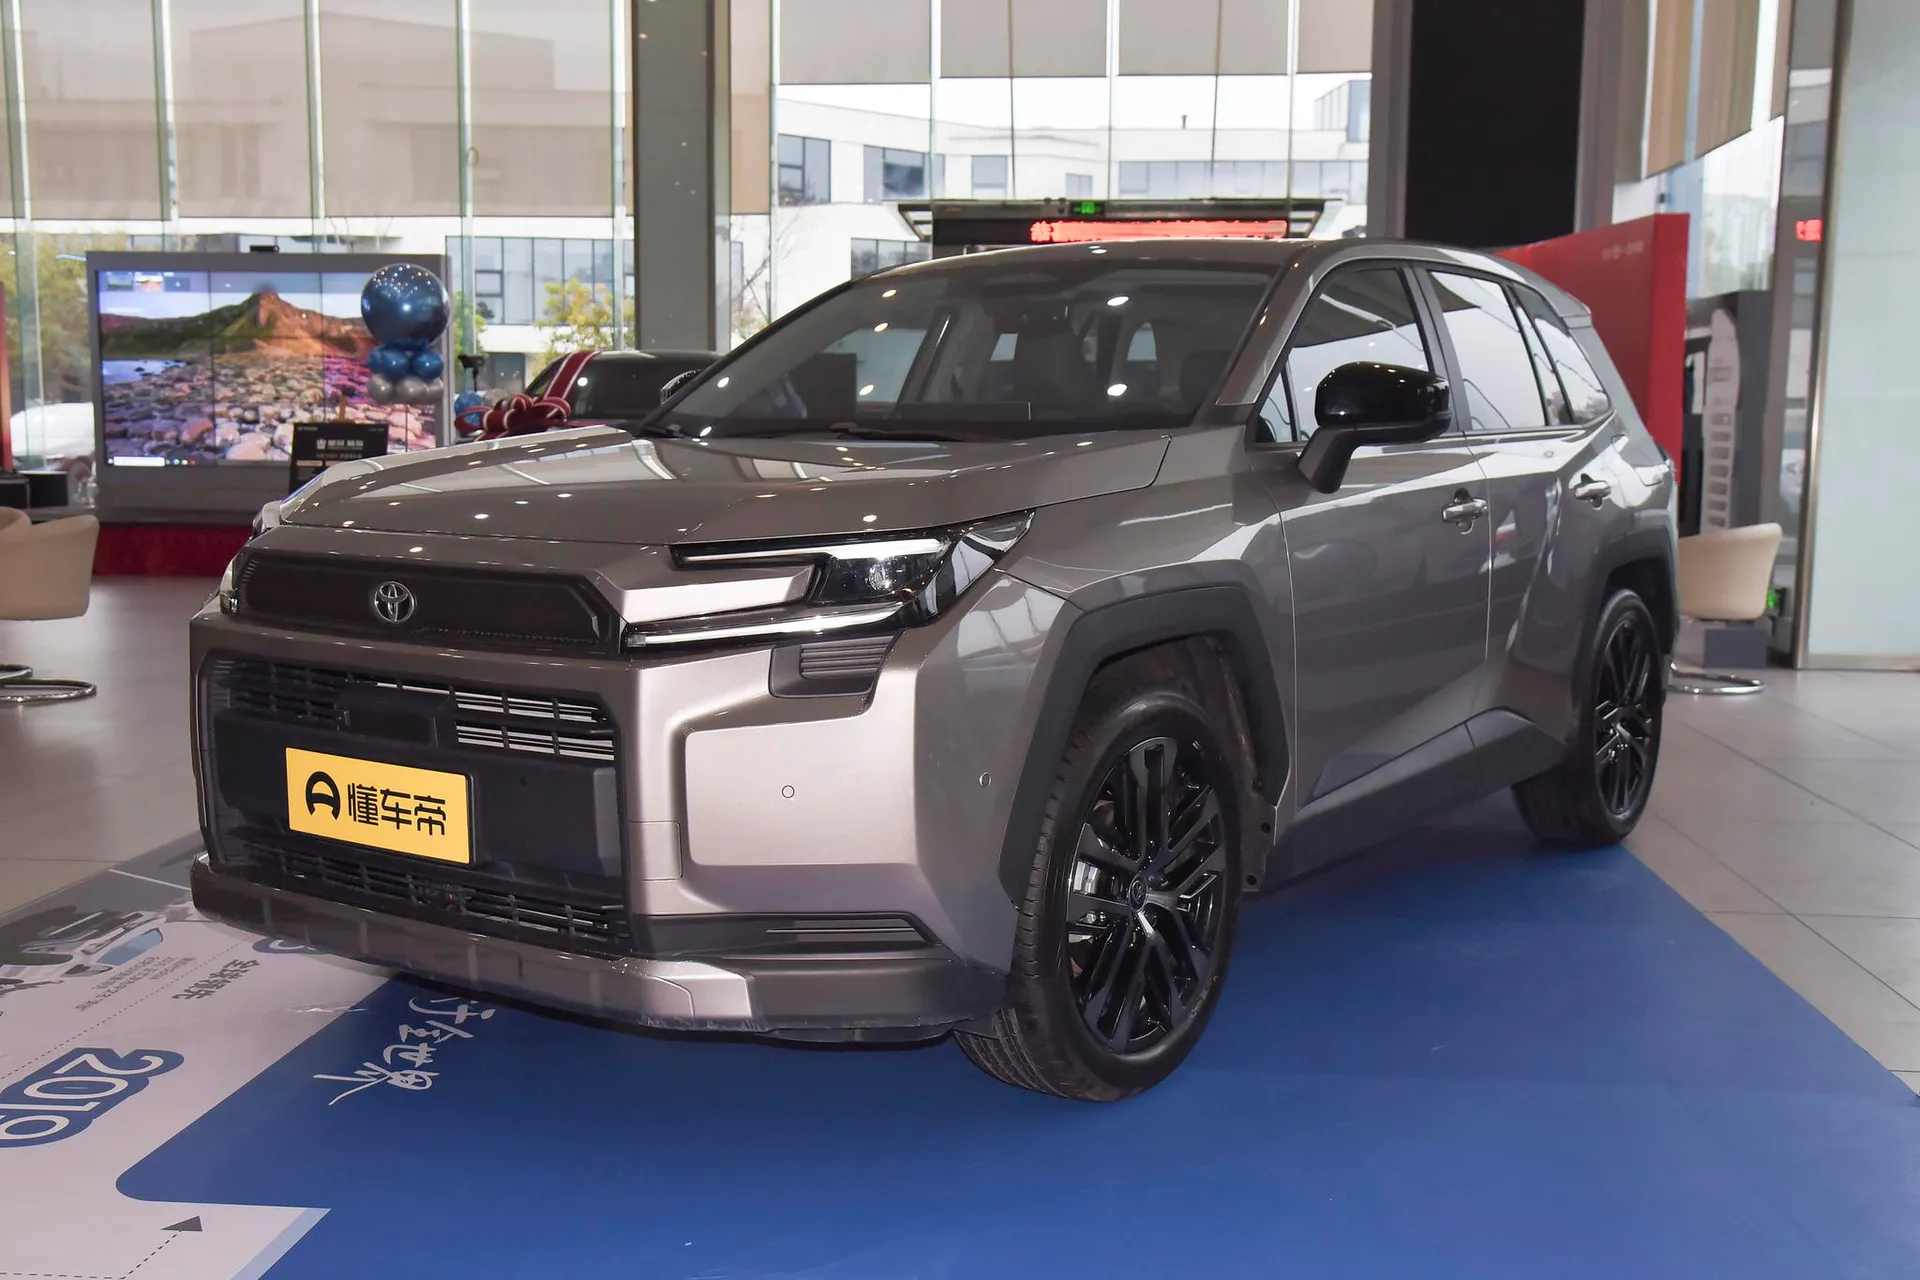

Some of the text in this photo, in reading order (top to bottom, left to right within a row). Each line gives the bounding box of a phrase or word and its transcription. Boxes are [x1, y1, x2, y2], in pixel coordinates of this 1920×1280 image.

[347, 783, 446, 836] 懂车帝
[171, 958, 261, 1001] 全球领先
